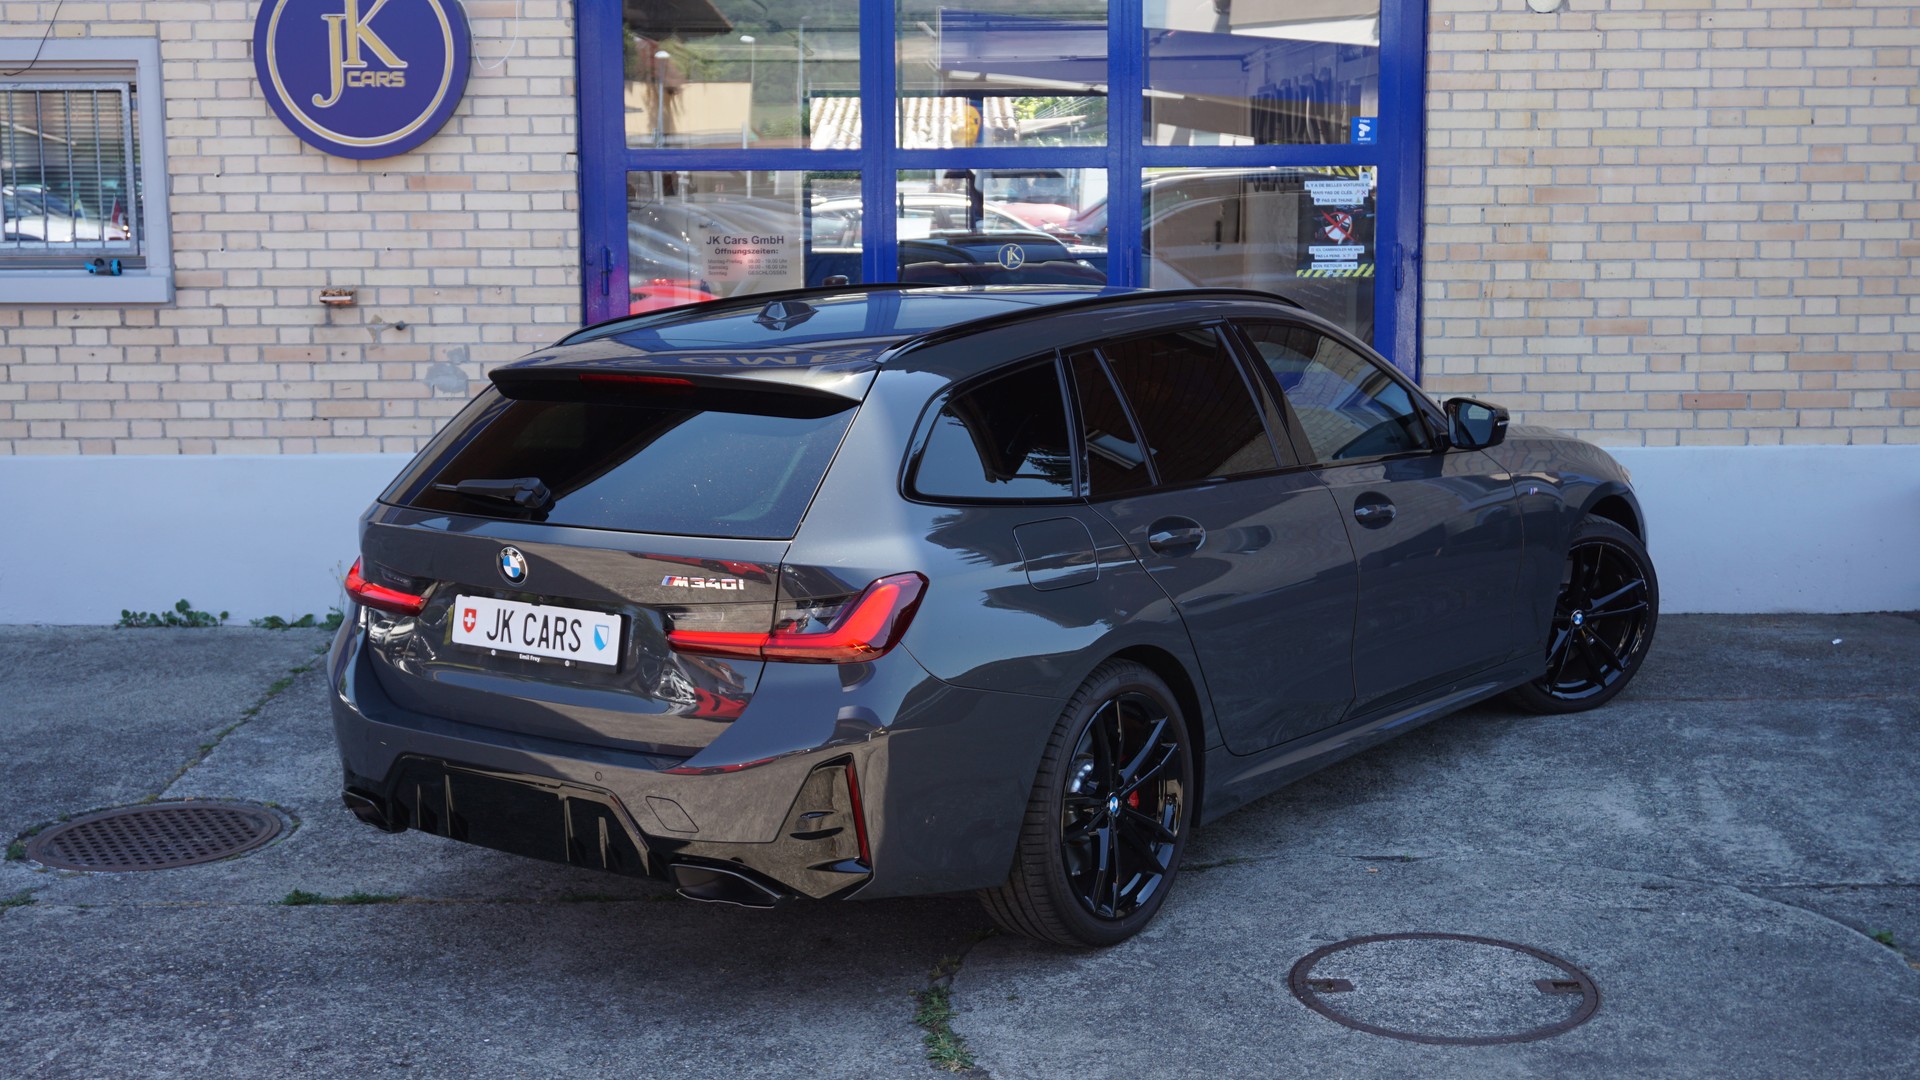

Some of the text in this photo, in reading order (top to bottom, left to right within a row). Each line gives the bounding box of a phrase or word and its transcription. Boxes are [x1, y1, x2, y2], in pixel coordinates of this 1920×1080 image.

[347, 71, 406, 88] CARS
[706, 235, 784, 245] JK Cars GmbH
[714, 247, 779, 256] Öffnungszeiten:
[486, 607, 583, 653] JK CARS
